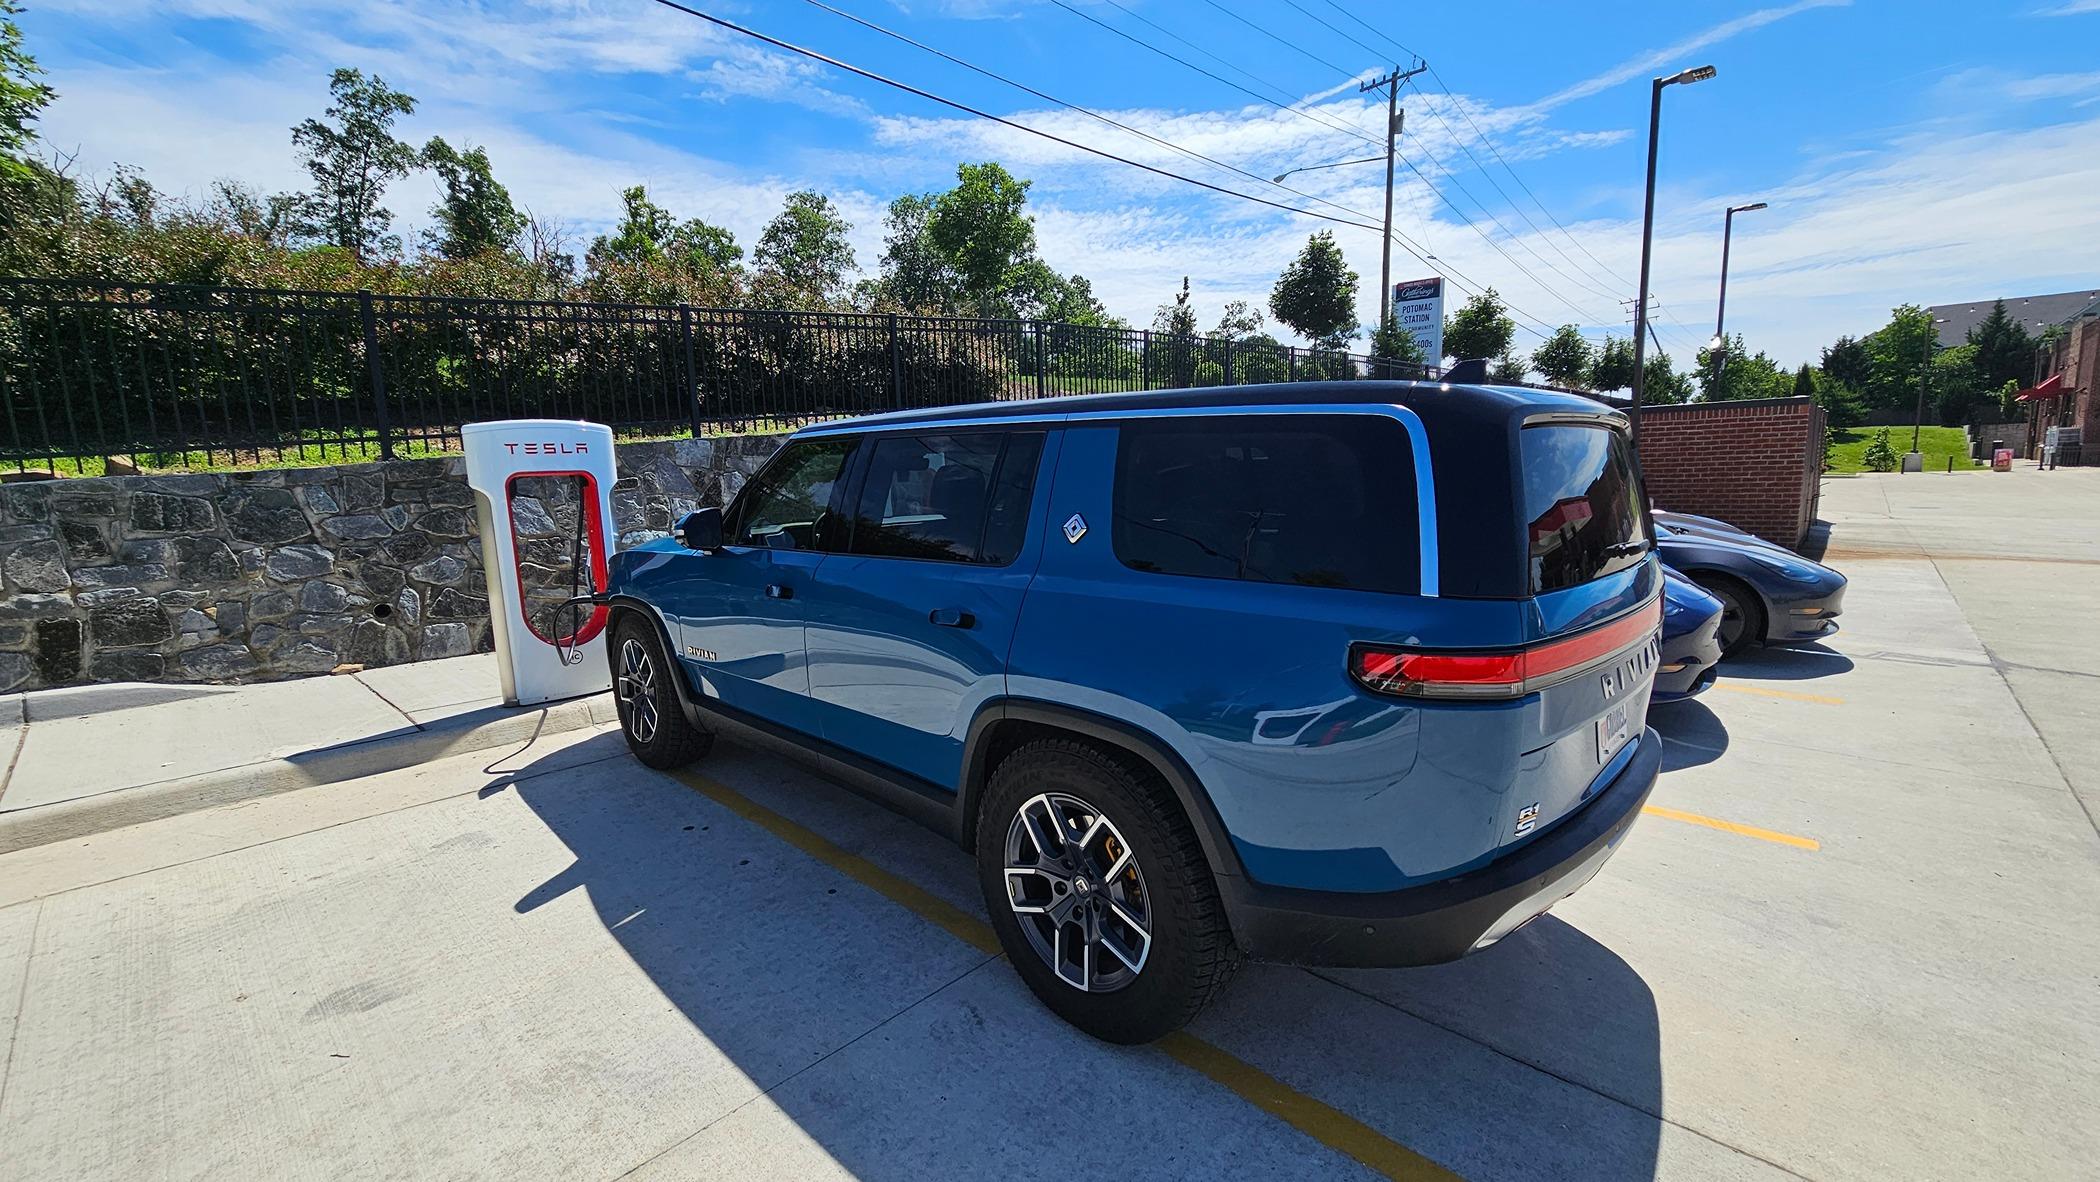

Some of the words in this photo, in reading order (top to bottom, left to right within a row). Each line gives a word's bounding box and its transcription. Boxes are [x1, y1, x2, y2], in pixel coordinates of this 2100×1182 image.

[1402, 302, 1433, 314] POTOMAC
[1404, 313, 1430, 325] STATION
[504, 443, 588, 455] TESLA
[688, 645, 717, 661] RIVIAN
